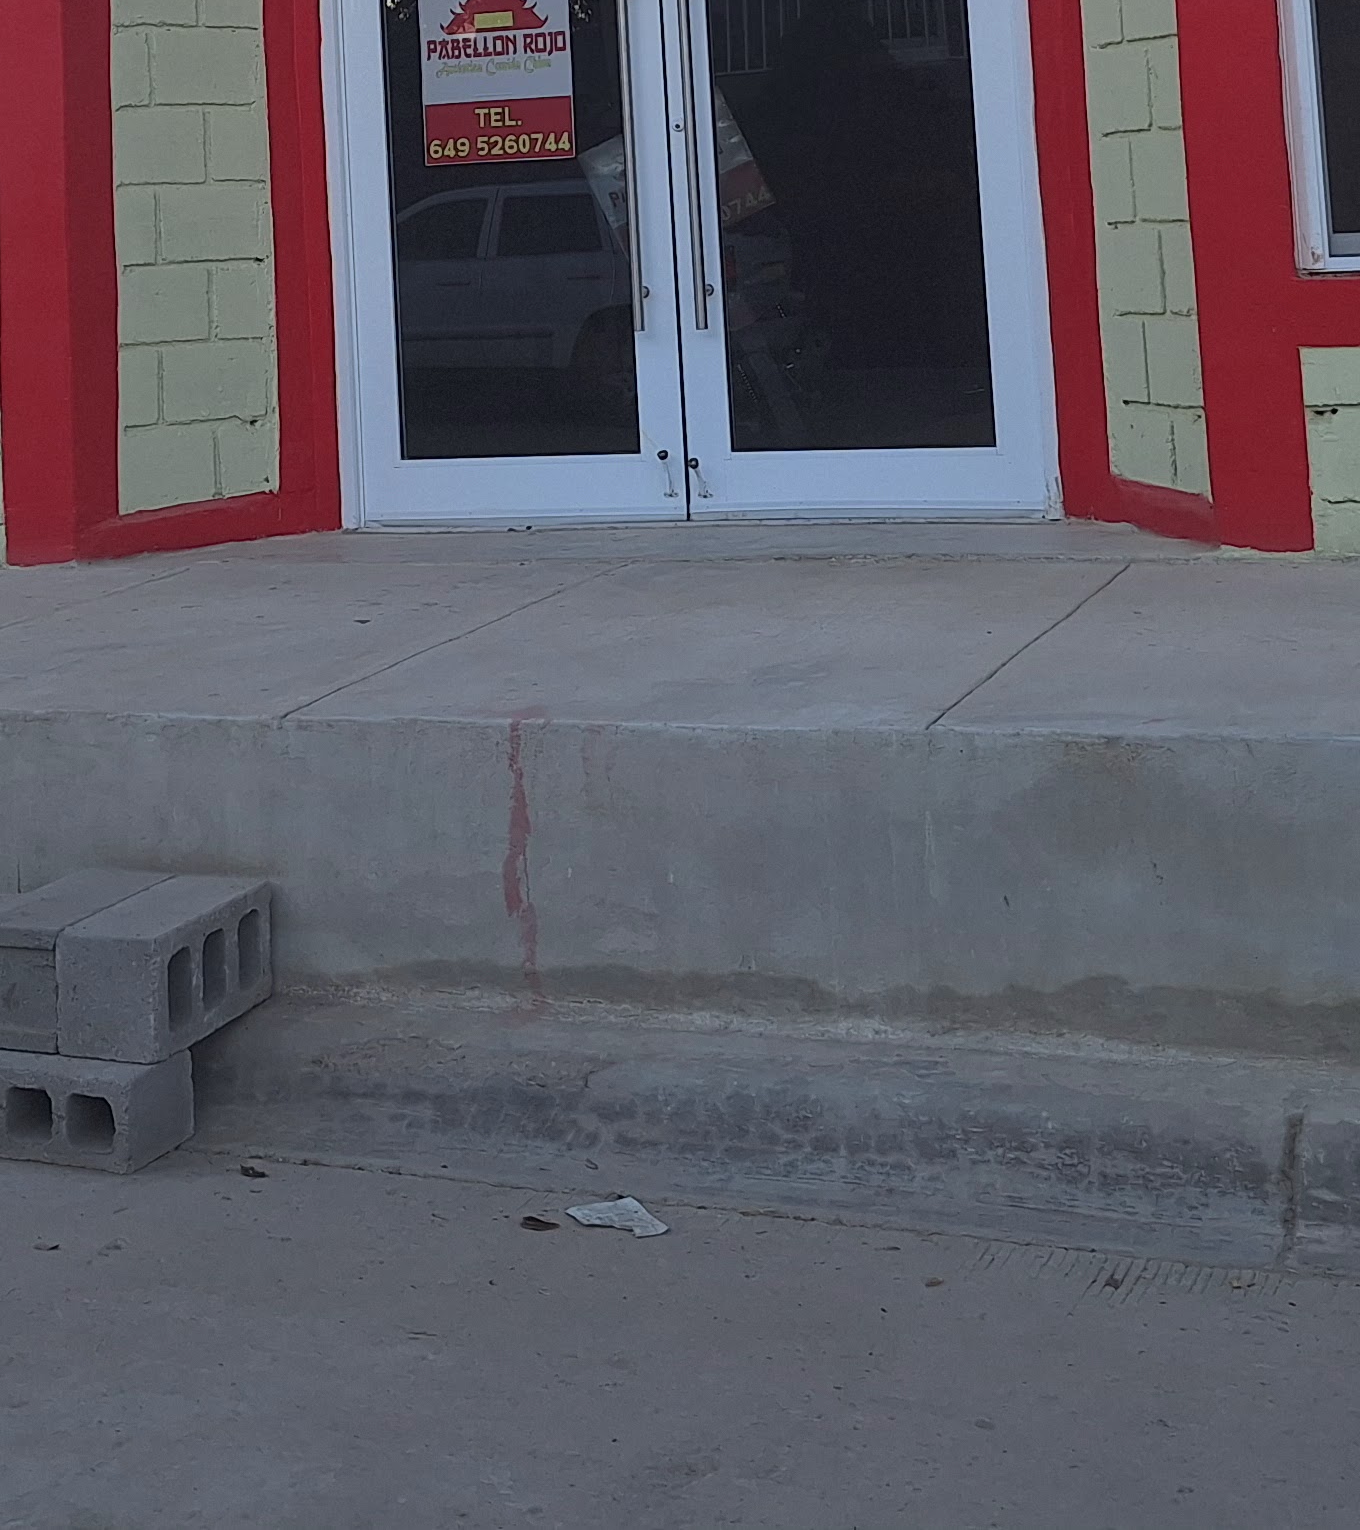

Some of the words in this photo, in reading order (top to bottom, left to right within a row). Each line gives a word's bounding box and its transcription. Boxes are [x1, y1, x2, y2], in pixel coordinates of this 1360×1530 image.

[426, 34, 517, 61] PABELLON
[522, 31, 567, 56] ROJO
[474, 106, 523, 128] TEL.
[429, 137, 471, 159] 649
[476, 131, 571, 156] 5260744
[721, 185, 771, 221] 0744
